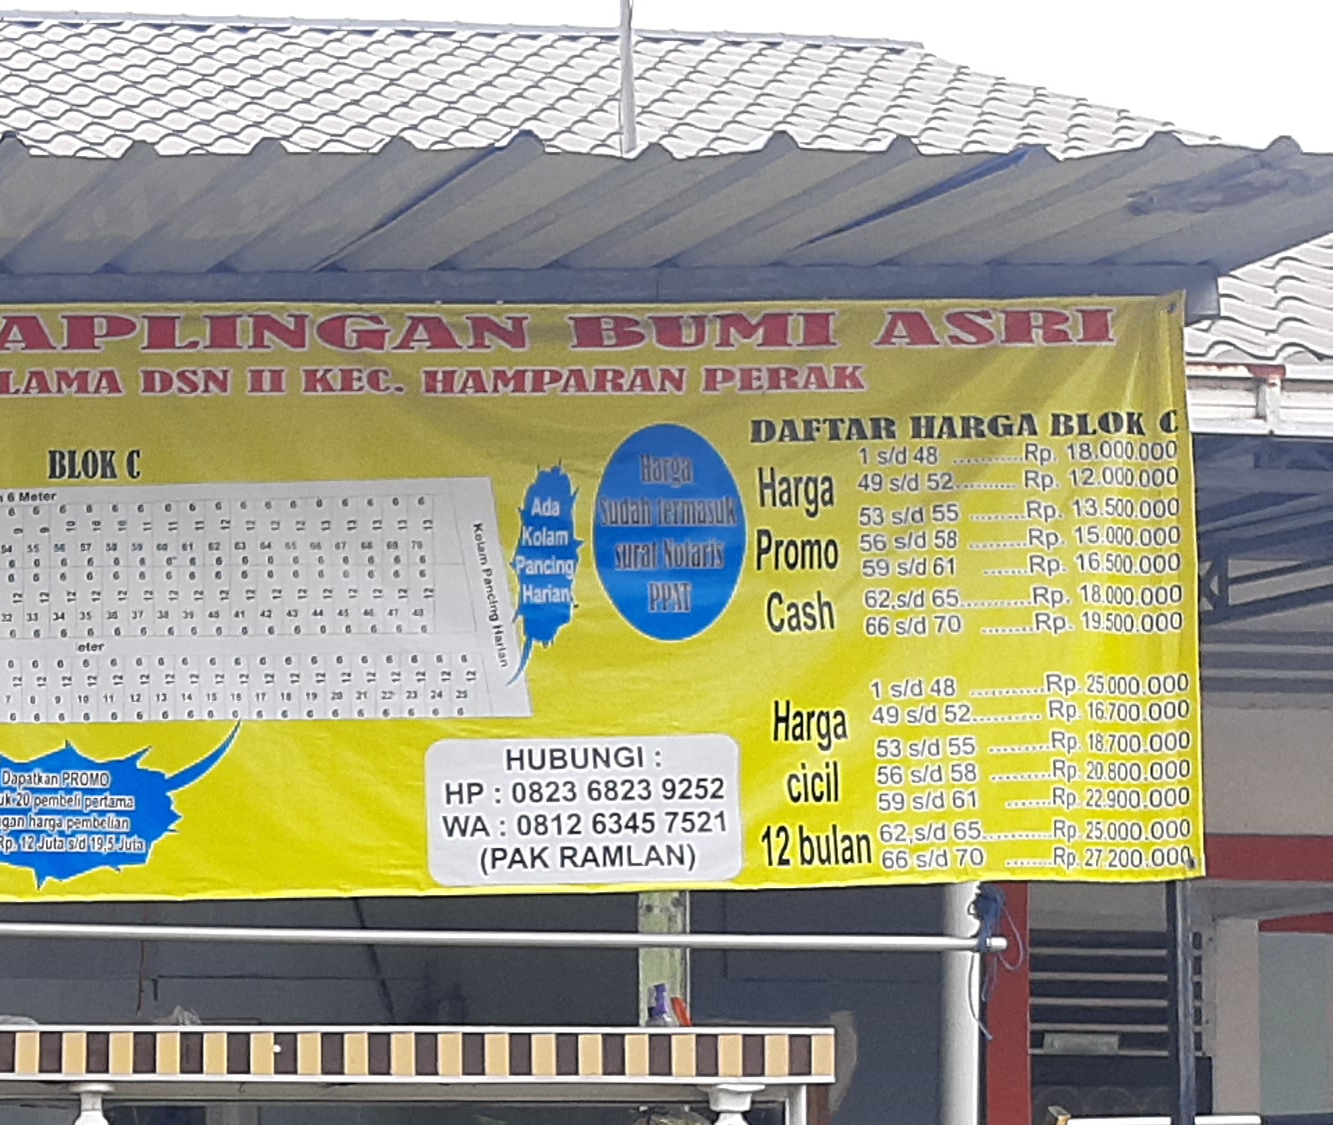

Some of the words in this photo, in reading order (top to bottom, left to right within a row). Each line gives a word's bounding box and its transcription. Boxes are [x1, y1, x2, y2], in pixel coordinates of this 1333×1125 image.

[568, 310, 838, 351] BUMI
[874, 307, 1116, 349] ASRI
[141, 367, 230, 395] DSN
[246, 368, 285, 394] II
[302, 367, 405, 395] KEC.
[422, 366, 686, 396] HAMPARAN
[702, 364, 866, 393] PERAK
[750, 415, 896, 444] DAFTAR
[910, 412, 1036, 441] HARGA
[1050, 410, 1145, 438] BLOK
[1160, 409, 1179, 435] C
[49, 449, 117, 480] BLOK
[125, 448, 141, 479] C
[859, 448, 867, 465] 1
[875, 446, 907, 466] s/d
[914, 445, 939, 464] 48
[1067, 438, 1179, 463] 18.000.000
[758, 466, 834, 518] Harga
[858, 474, 883, 492] 49
[890, 472, 919, 493] s/d
[1069, 467, 1180, 491] 12.000.000
[531, 497, 561, 517] Ada
[521, 526, 569, 547] Kolam
[756, 529, 838, 572] Promo
[515, 555, 575, 579] Pancing
[521, 583, 572, 604] Harian
[767, 590, 834, 633] Cash
[773, 701, 848, 751] Harga
[504, 746, 648, 773] HUBUNGI
[444, 781, 484, 806] HP
[511, 779, 577, 805] 0823
[587, 777, 652, 804] 6823
[660, 776, 725, 802] 9252
[787, 762, 840, 805] cicil
[443, 813, 490, 838] WA
[517, 813, 583, 838] 0812
[590, 812, 657, 837] 6345
[664, 810, 727, 836] 7521
[480, 843, 551, 873] (PAK
[559, 842, 696, 872] RAMLAN)
[761, 825, 793, 867] 12
[799, 824, 873, 867] bulan
